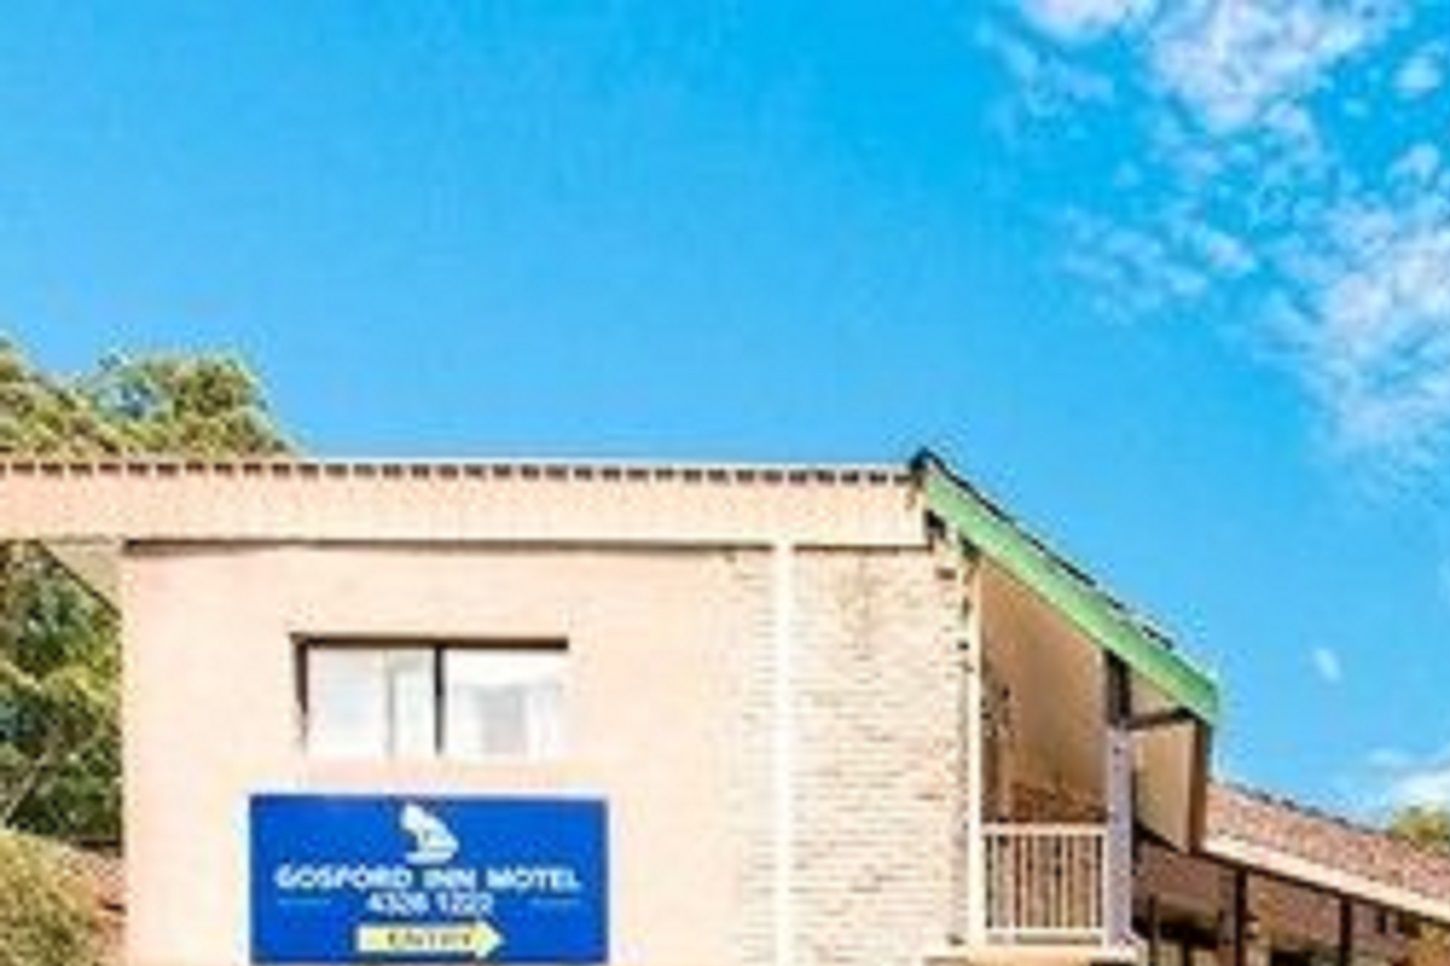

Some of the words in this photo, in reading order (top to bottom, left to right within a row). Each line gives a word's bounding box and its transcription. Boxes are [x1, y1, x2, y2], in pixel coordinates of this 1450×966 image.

[274, 864, 412, 890] GOSFORD
[422, 867, 477, 890] INN
[486, 867, 581, 890] MOTEL
